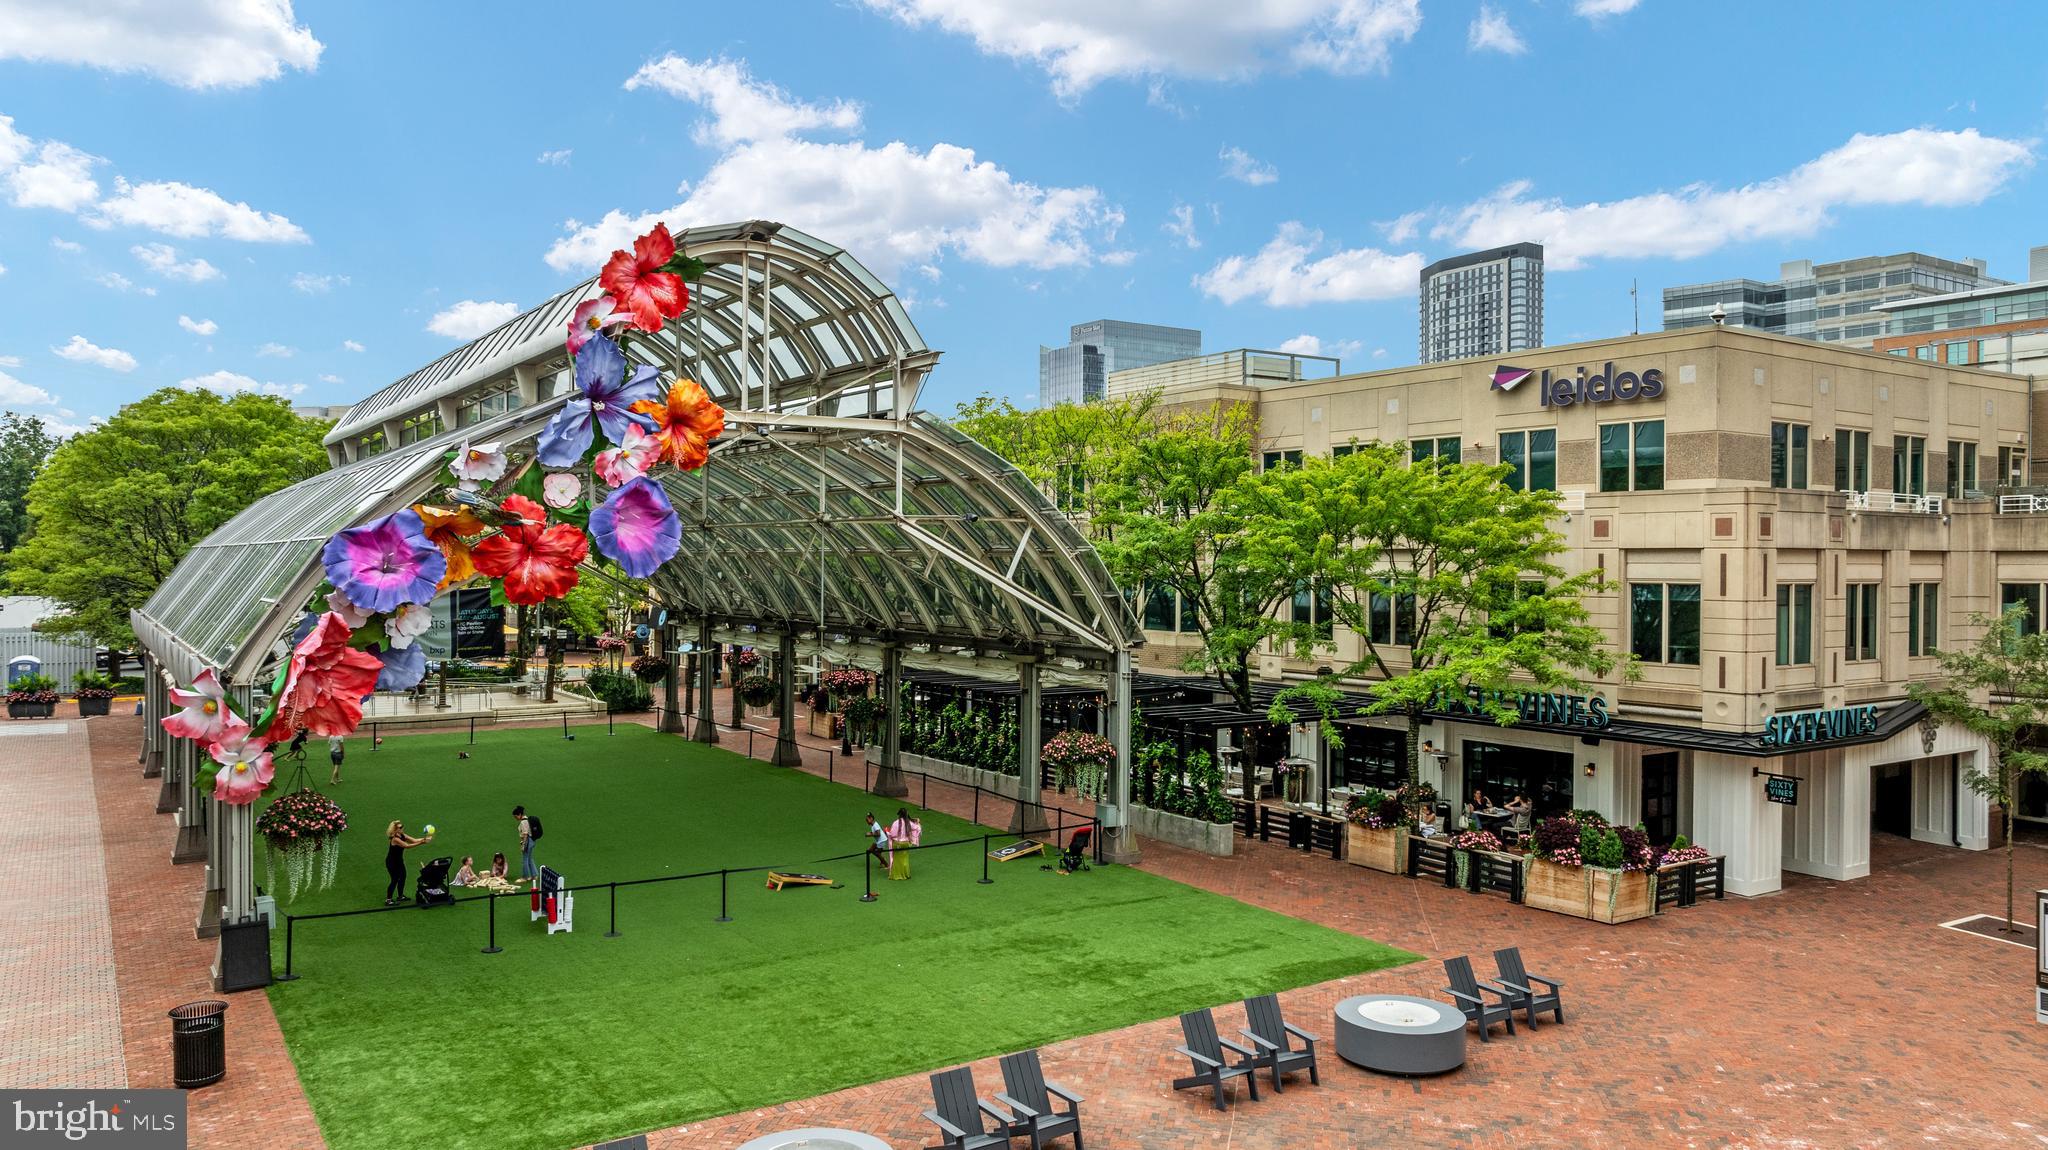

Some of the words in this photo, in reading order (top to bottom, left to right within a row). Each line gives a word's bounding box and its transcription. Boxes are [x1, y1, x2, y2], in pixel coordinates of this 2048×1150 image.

[1540, 361, 1664, 407] leidos
[429, 646, 446, 656] bxp
[1516, 689, 1609, 728] VINES
[1760, 709, 1824, 746] SIXTY
[1823, 704, 1878, 738] VINES
[1769, 780, 1794, 790] SIXTY
[1769, 787, 1794, 798] VINES
